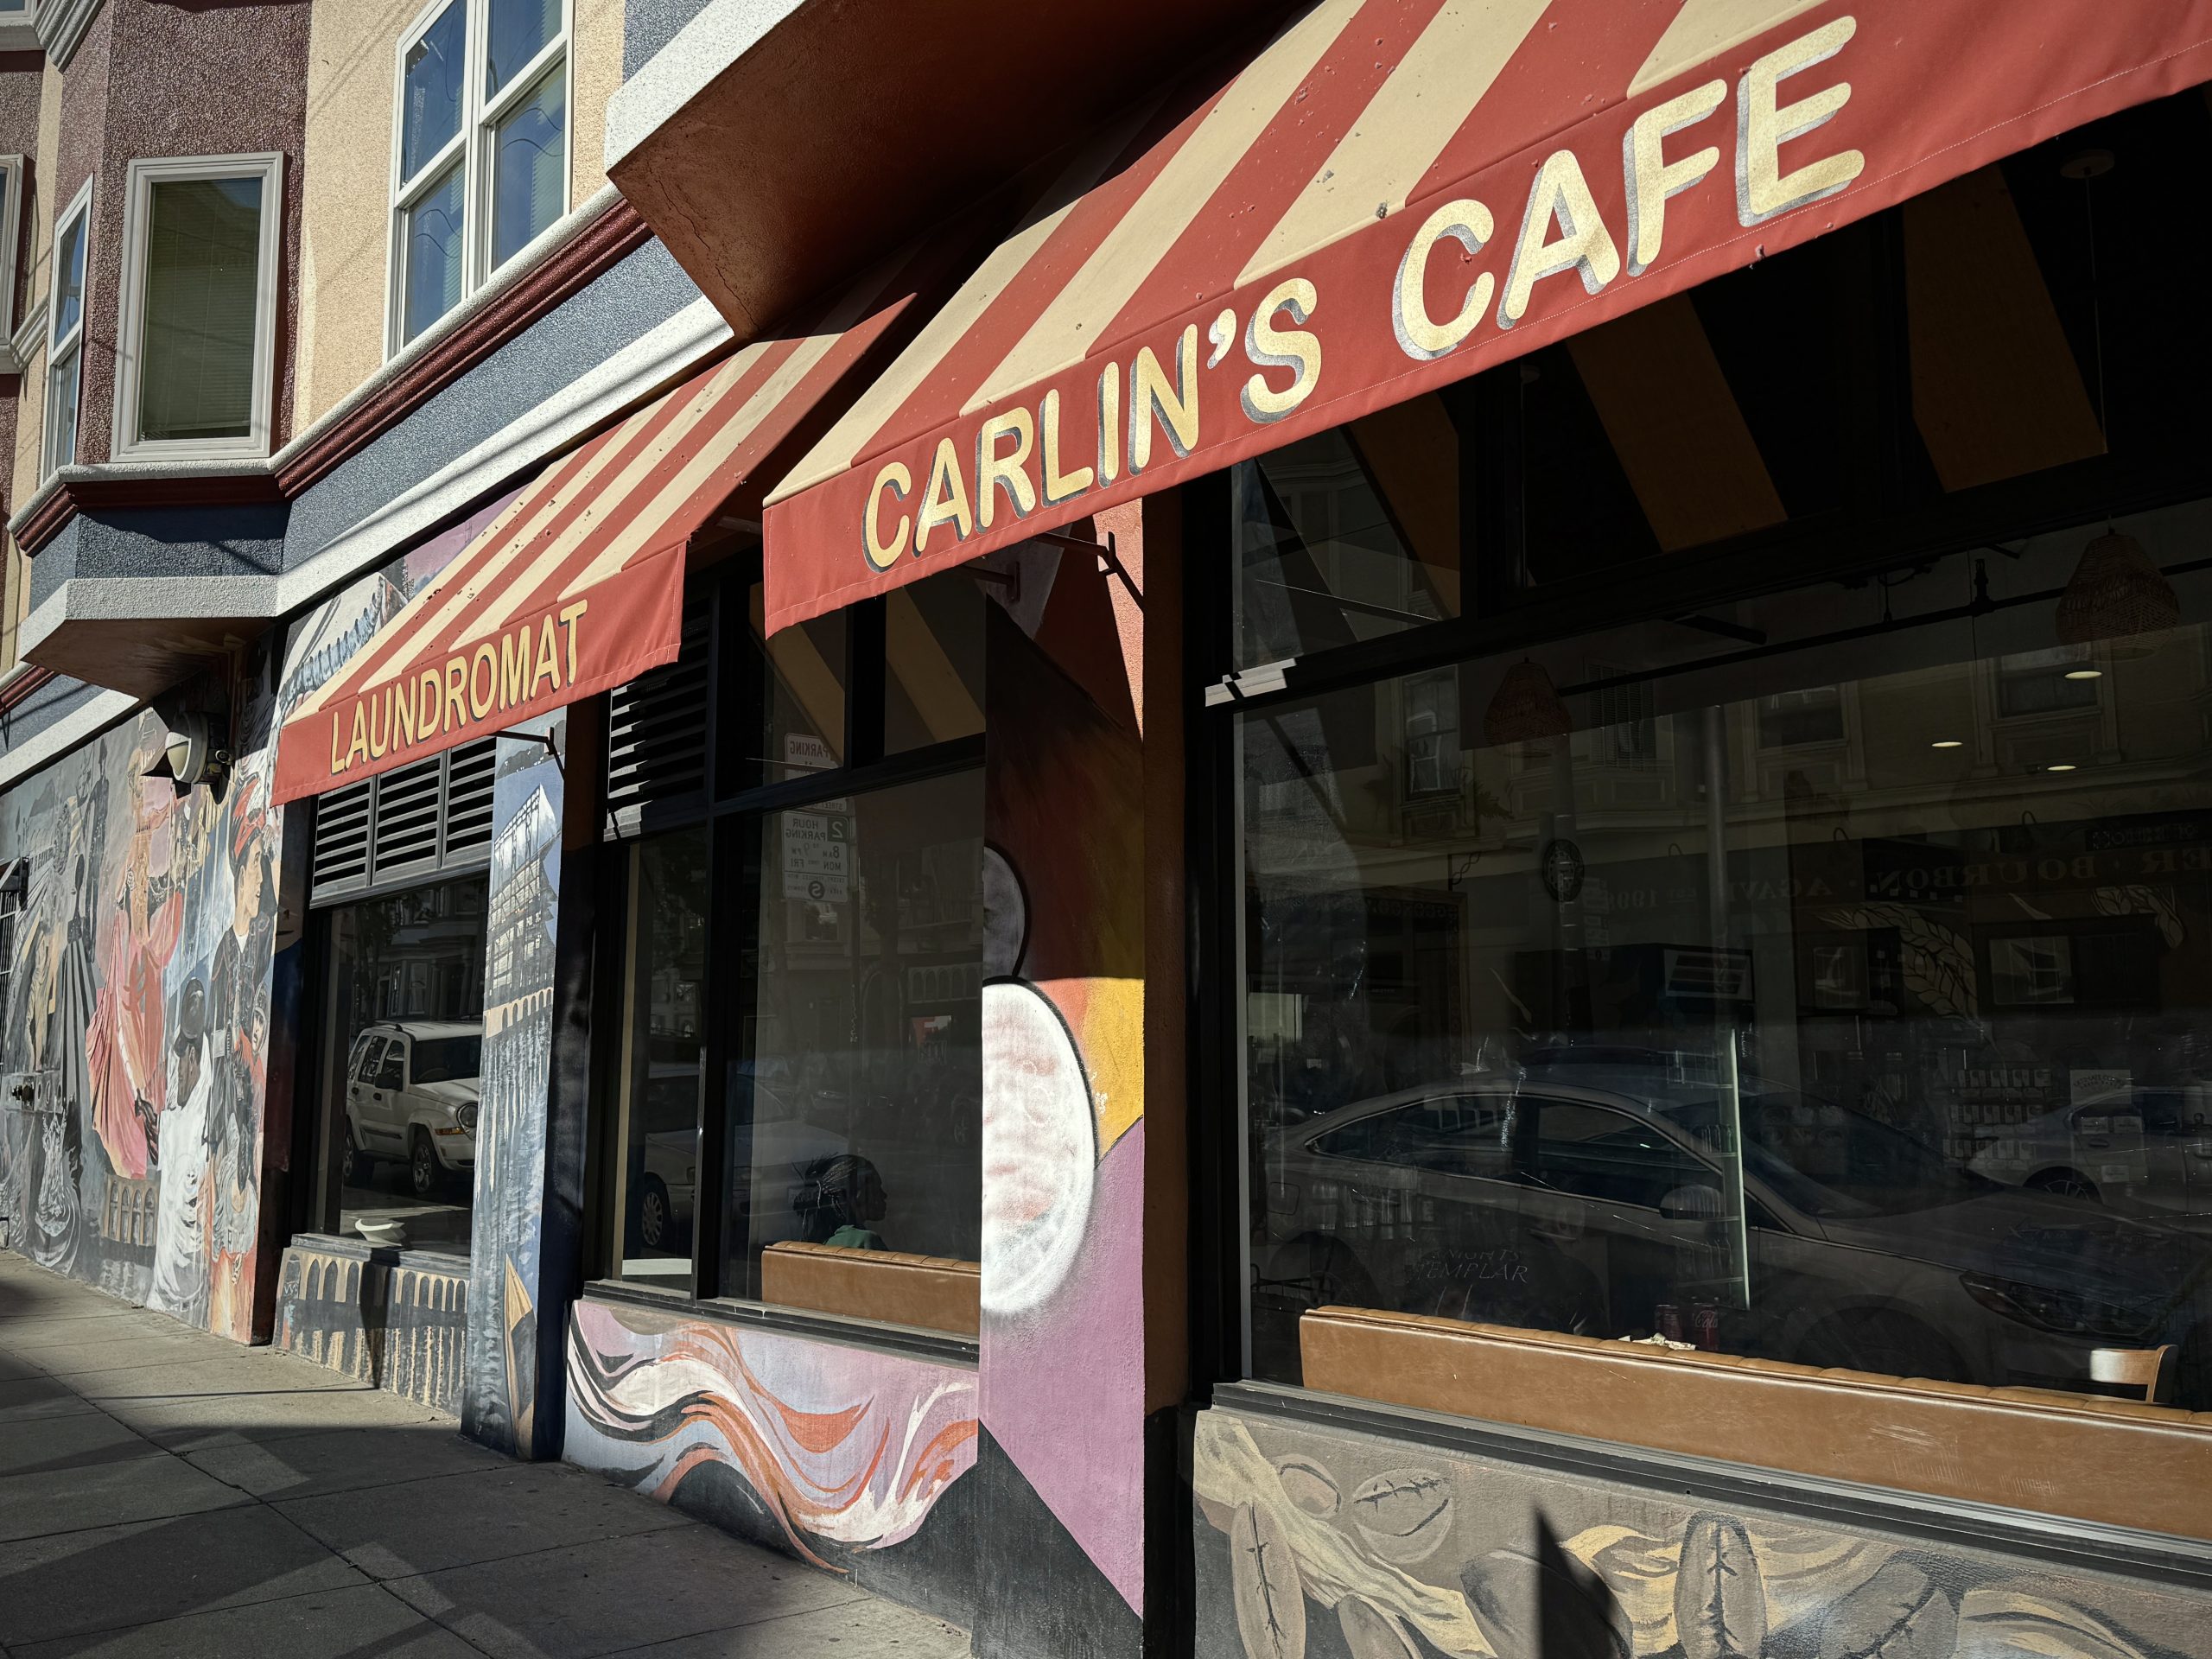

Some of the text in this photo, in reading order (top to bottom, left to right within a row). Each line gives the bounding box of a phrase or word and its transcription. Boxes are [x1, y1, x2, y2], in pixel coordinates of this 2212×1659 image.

[862, 16, 1865, 573] CARLIN'S CAFE
[330, 599, 588, 775] LAUNDROMAT
